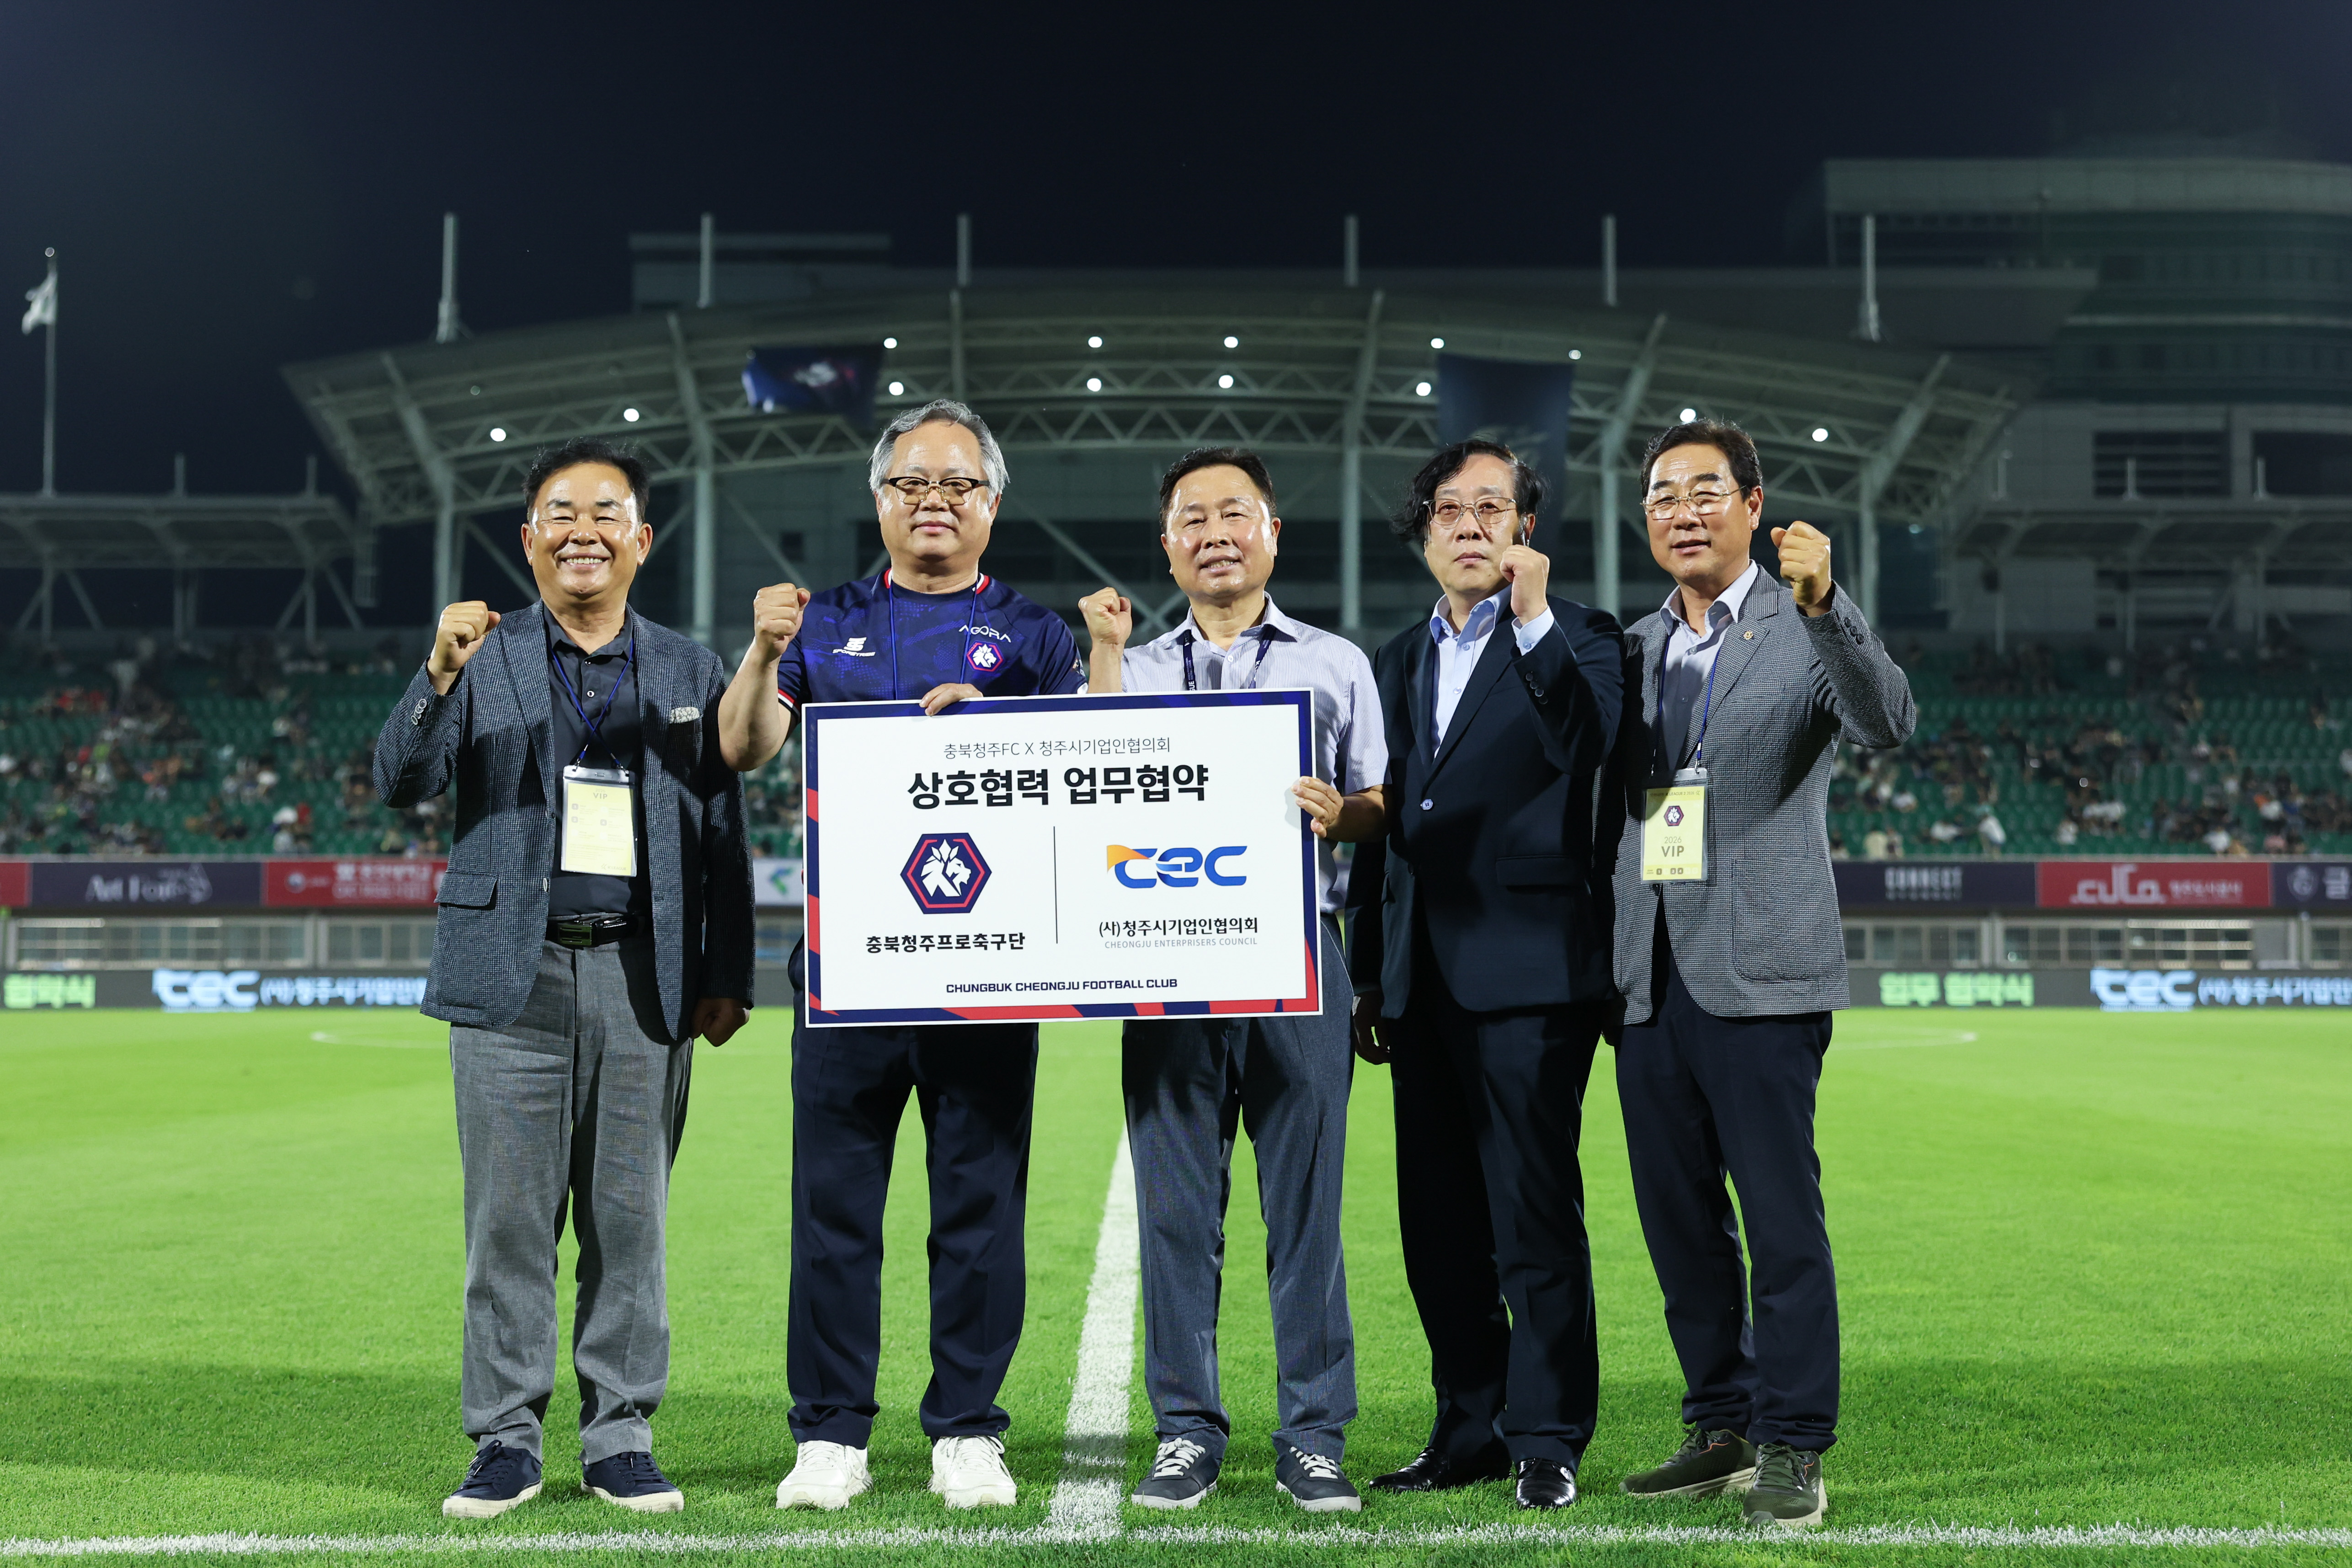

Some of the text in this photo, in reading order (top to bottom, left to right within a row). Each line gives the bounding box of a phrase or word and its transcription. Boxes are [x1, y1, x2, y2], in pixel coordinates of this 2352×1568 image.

[944, 737, 1170, 759] 충북청주FC X 청주시기업인협의회
[907, 765, 1209, 809] 상호협력 업무협약
[1662, 846, 1684, 857] VIP
[866, 932, 1025, 954] 충북청주프로축구단
[1105, 937, 1258, 949] CHEONGJU ENTERPRISERS COUNCIL
[946, 979, 1178, 993] CHUNGBUK CHEONGJU FOOTBALL CLUB
